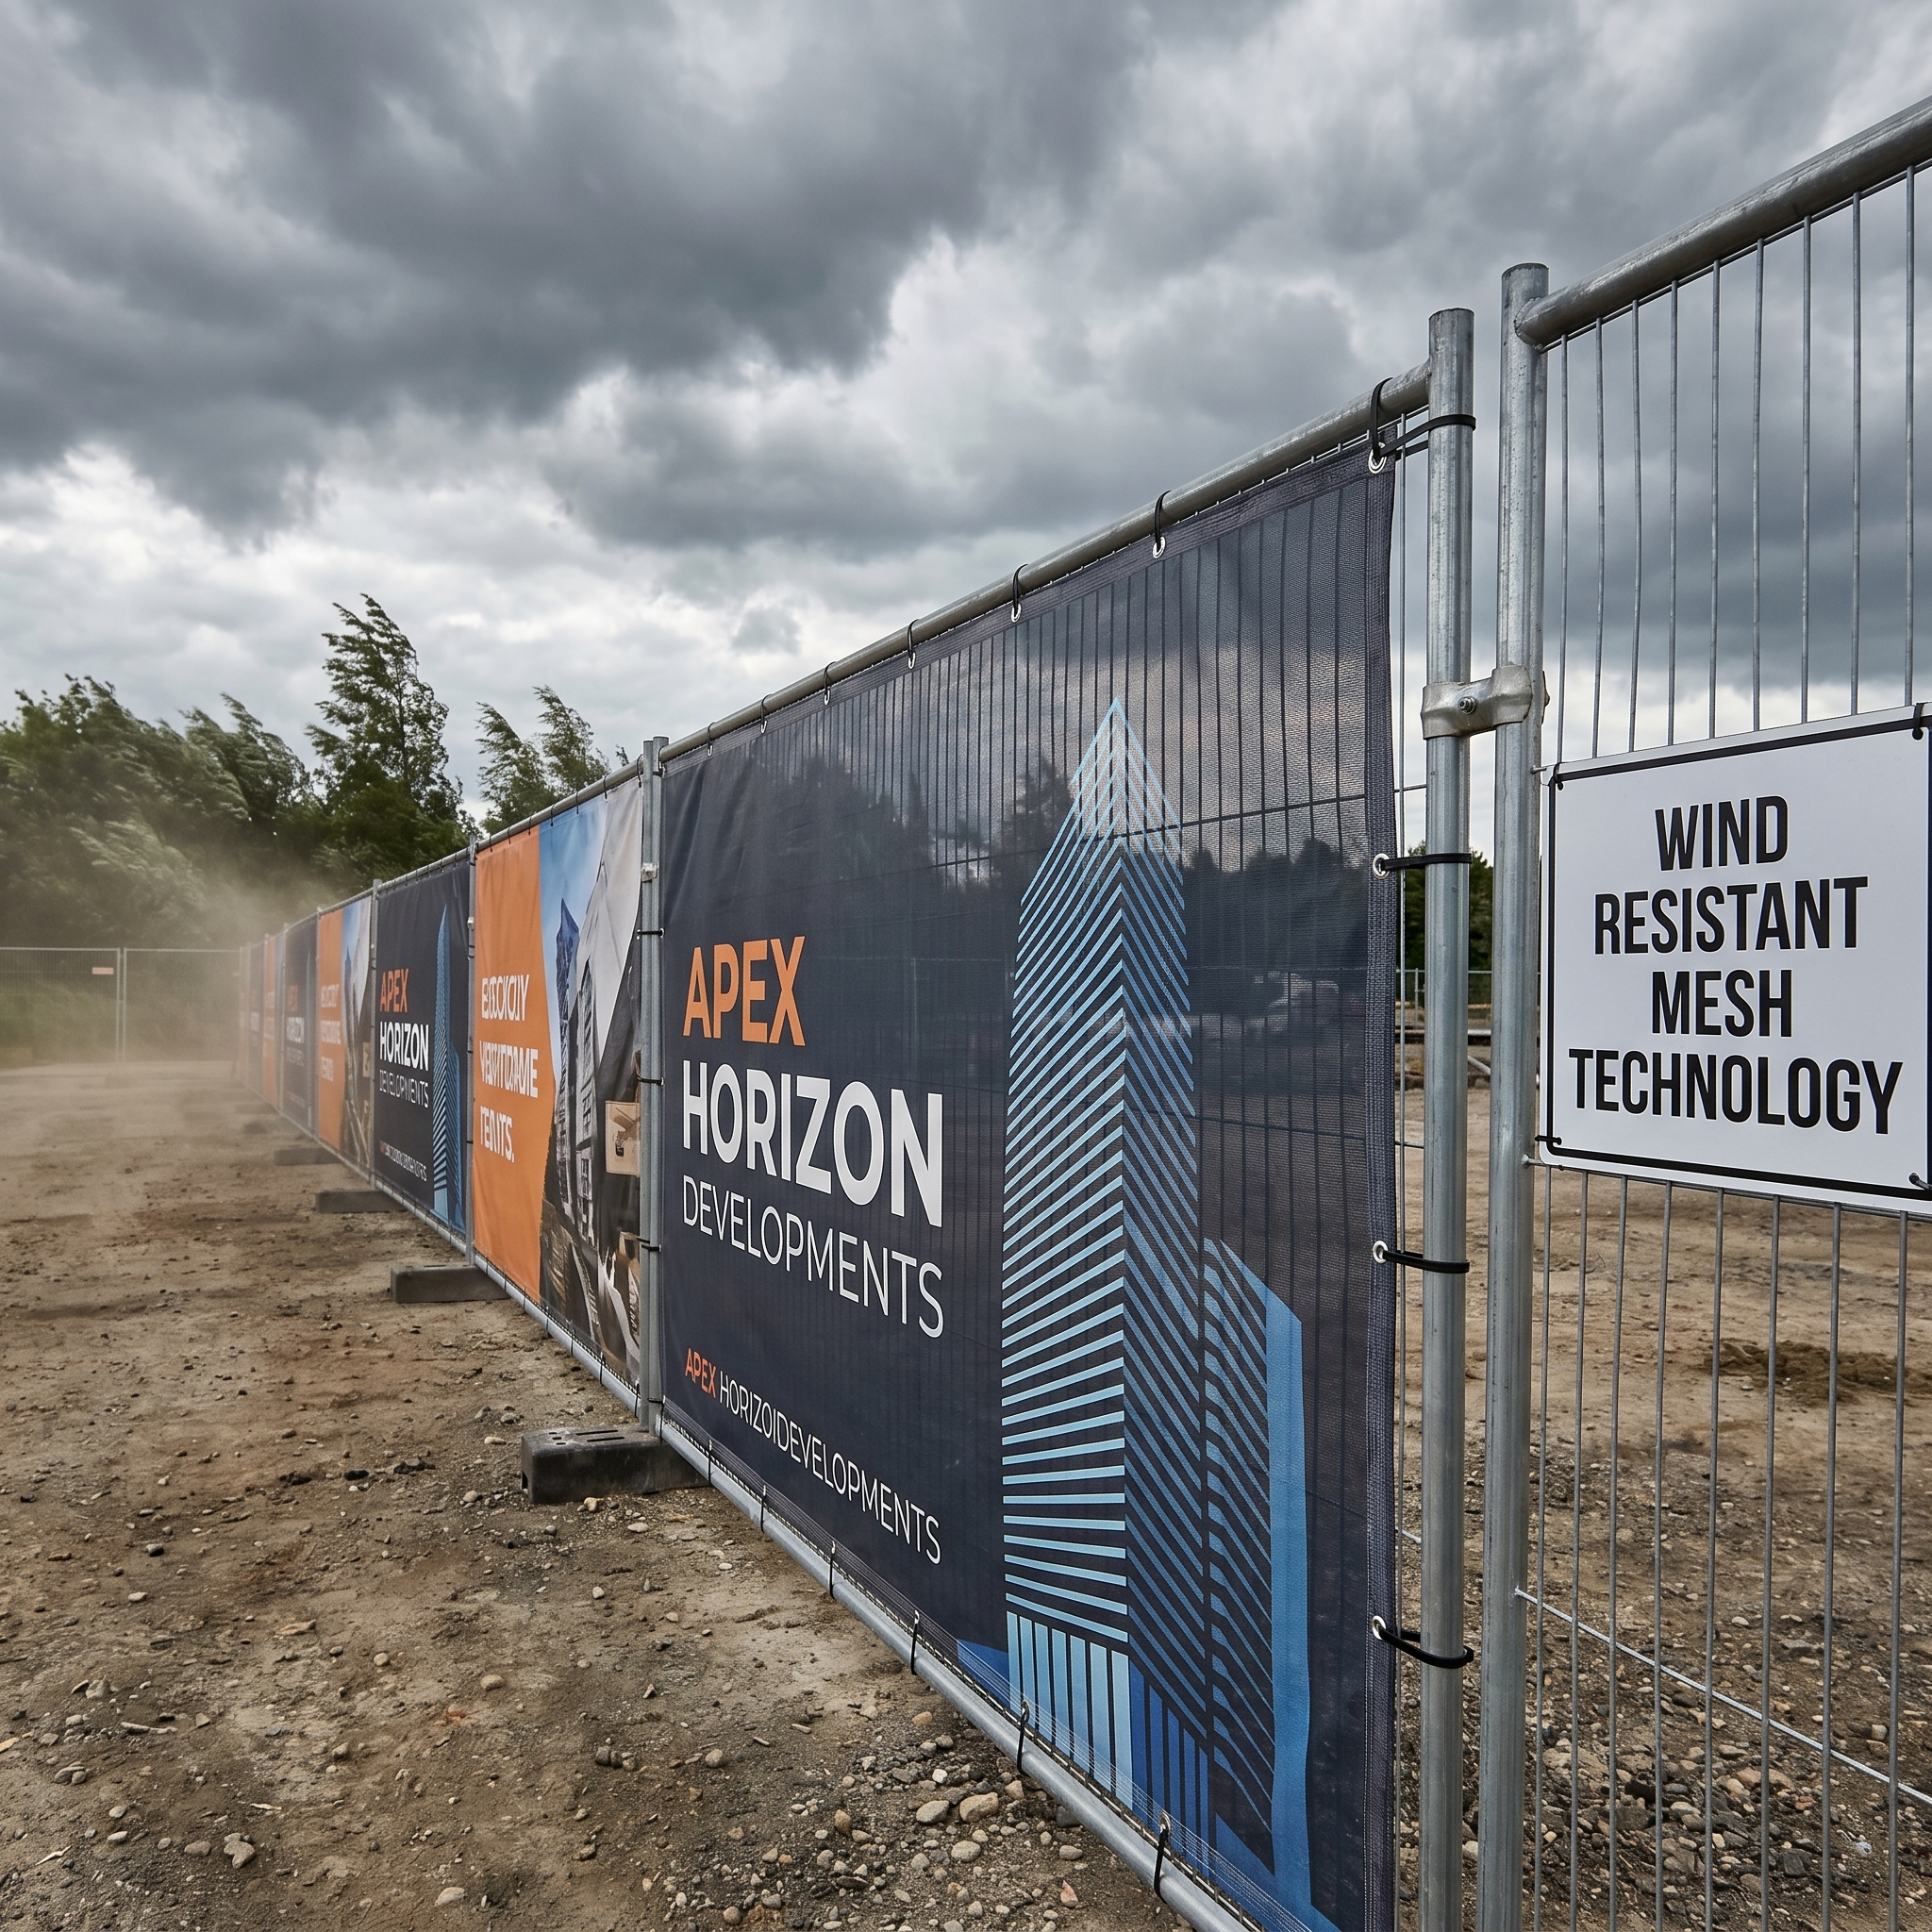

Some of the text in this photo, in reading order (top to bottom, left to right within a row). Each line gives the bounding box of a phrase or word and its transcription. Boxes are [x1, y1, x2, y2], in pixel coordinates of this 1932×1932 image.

[1655, 795, 1789, 872] WIND
[1594, 875, 1869, 955] RESISTANT
[379, 968, 409, 1013] APEX
[683, 935, 806, 1046] APEX
[1652, 969, 1792, 1038] MESH
[379, 1021, 429, 1072] HORIZON
[1568, 1048, 1904, 1135] TECHNOLOGY
[683, 1059, 943, 1228] HORIZON
[683, 1174, 944, 1339] DEVELOPMENTS
[685, 1347, 717, 1399] APEX
